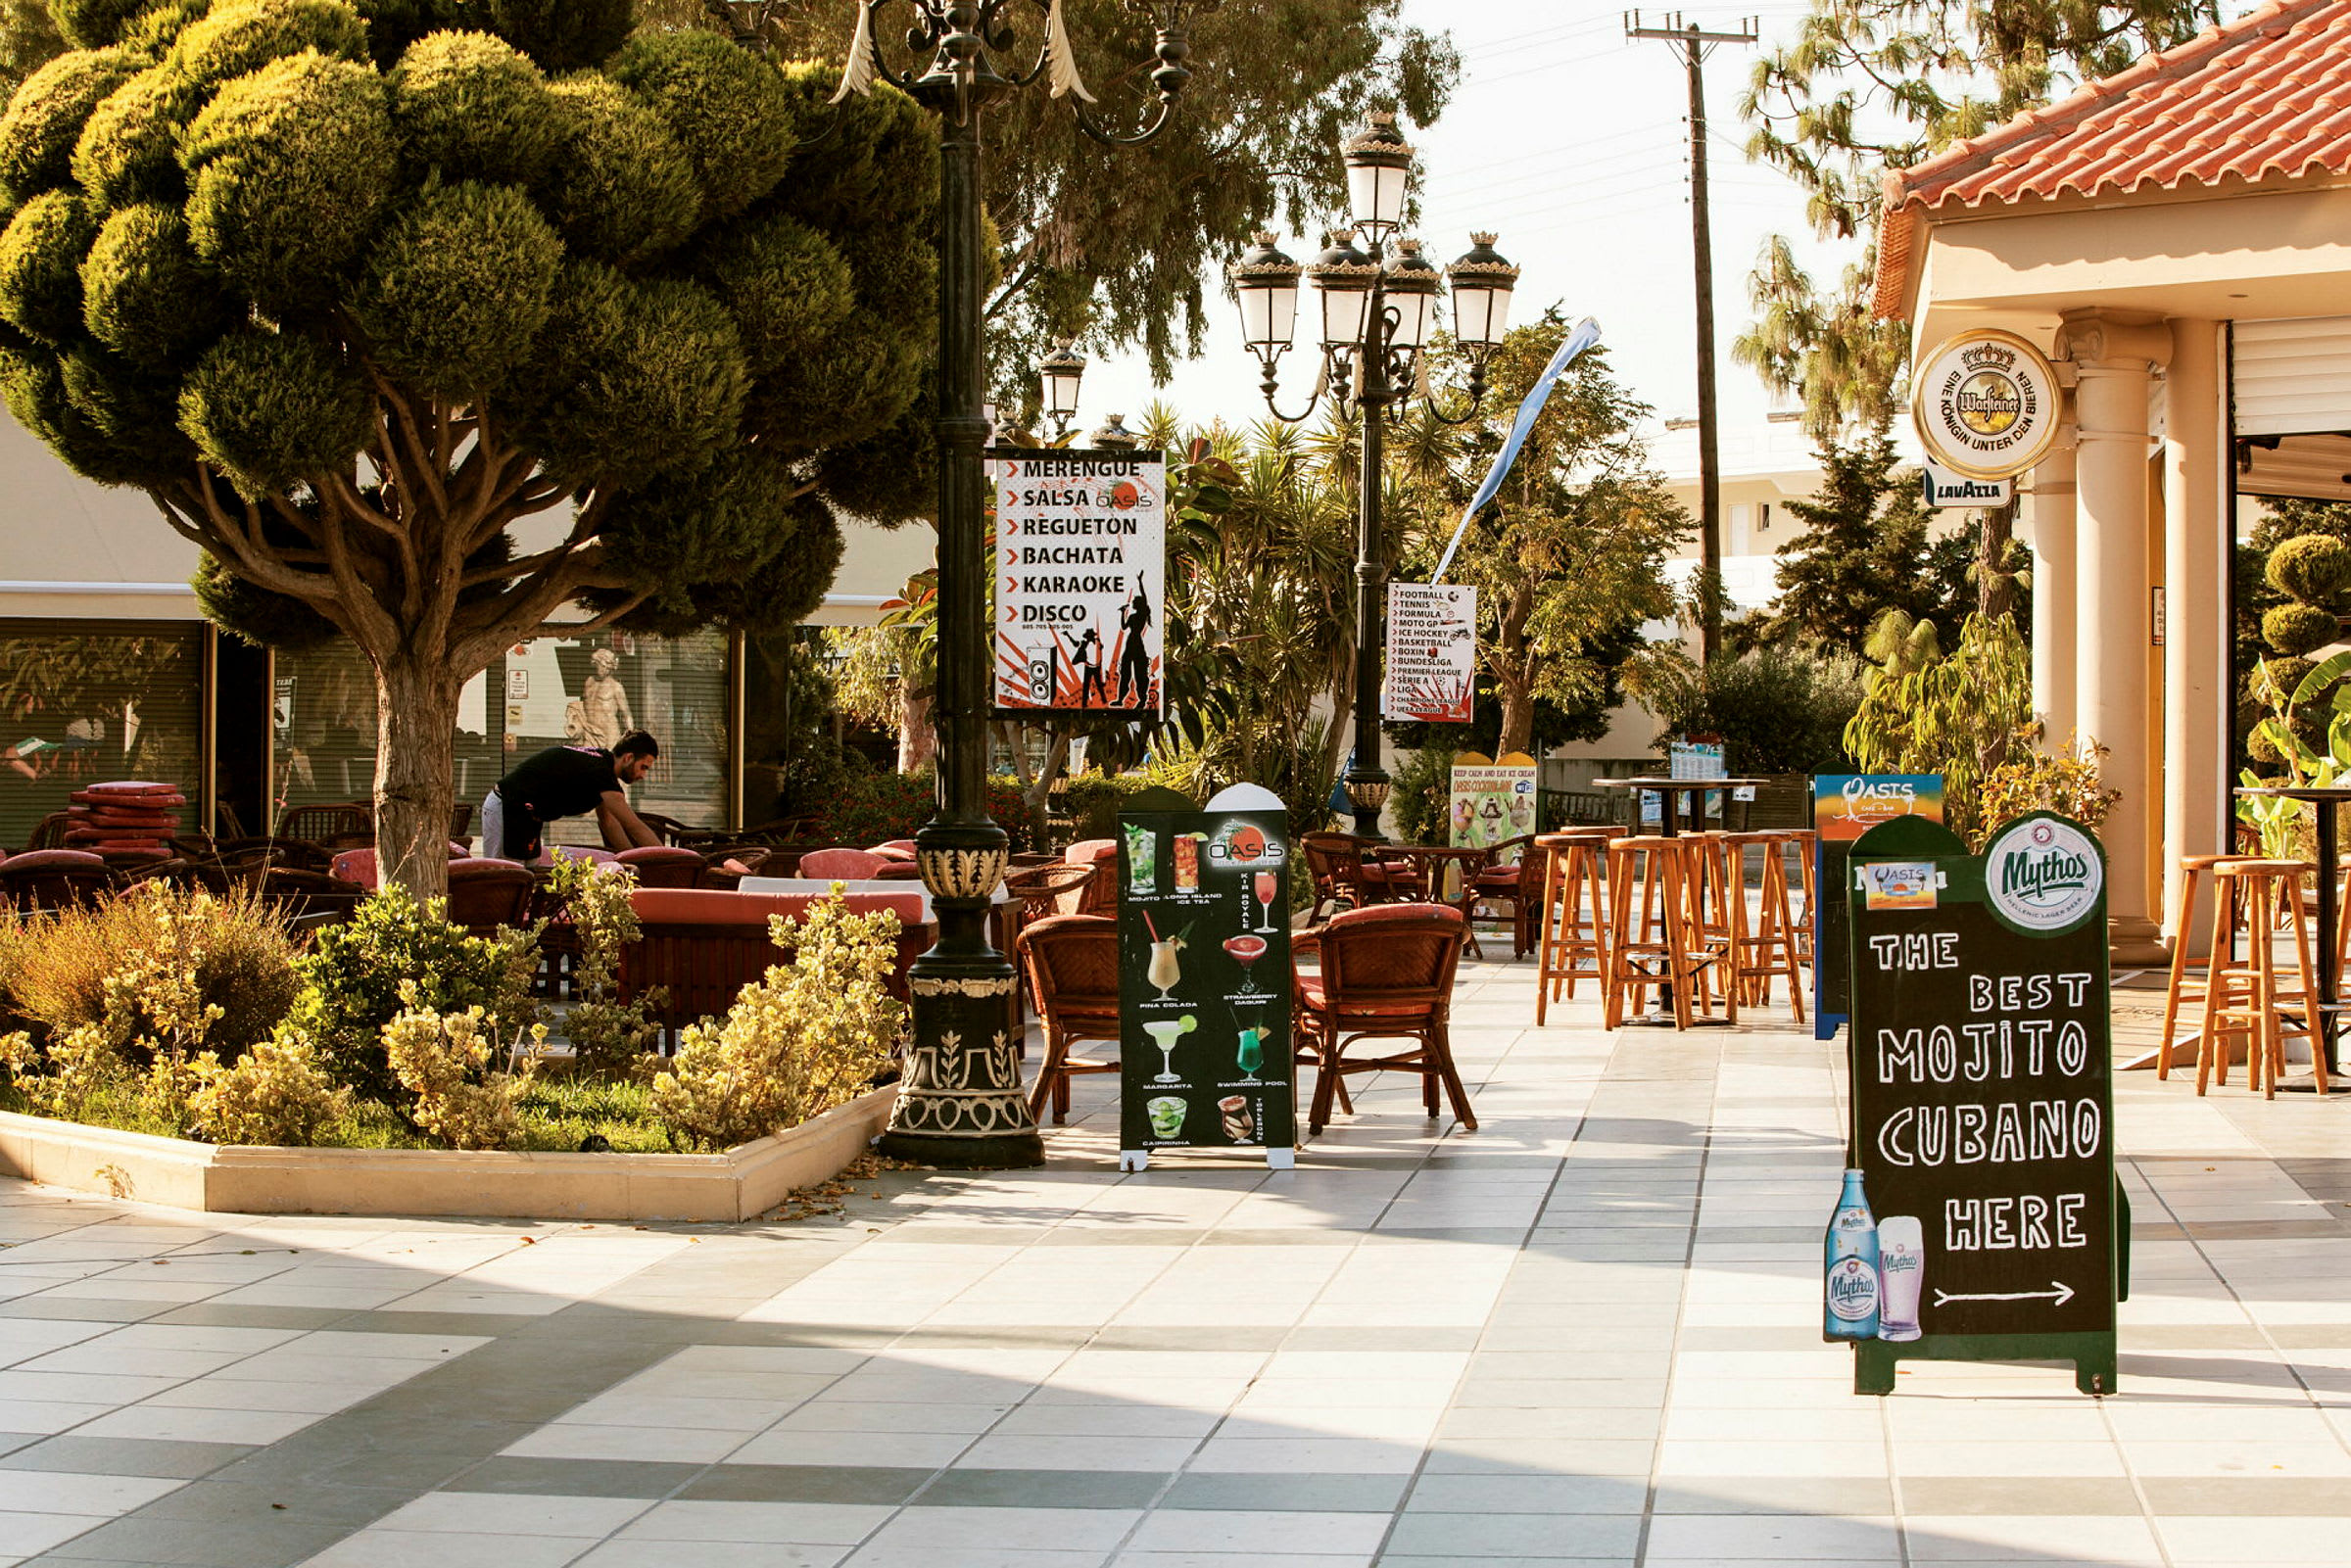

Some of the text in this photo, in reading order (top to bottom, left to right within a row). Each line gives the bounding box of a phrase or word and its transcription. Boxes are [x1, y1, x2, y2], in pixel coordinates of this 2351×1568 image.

[1941, 370, 2037, 451] EINE KÖNIGIN UNTER DEN BIEREN
[1024, 461, 1139, 477] MERENGUE
[1024, 489, 1089, 506] SALSA
[1937, 481, 2000, 499] LAVAZZA
[1096, 495, 1152, 508] OASIS
[1024, 518, 1136, 535] REGUETON
[1023, 547, 1124, 564] BACHATA
[1024, 576, 1125, 593] KARAOKE
[1024, 604, 1086, 622] DISCO
[1398, 639, 1452, 647] BASKETBALL
[1398, 657, 1452, 666] BUNDESLIGA
[1843, 778, 1913, 799] OASIS
[1210, 843, 1283, 858] OASIS
[1240, 873, 1249, 890] KIR
[2002, 850, 2087, 898] Mythos
[2007, 897, 2083, 918] HELLENIC LAGER BEER
[1869, 932, 1959, 971] THE
[1969, 973, 2091, 1013] BEST
[1878, 1098, 2100, 1166] CUBANO
[1945, 1193, 2087, 1251] HERE
[1883, 1253, 1917, 1272] Mythos
[1831, 1275, 1875, 1304] Mythos
